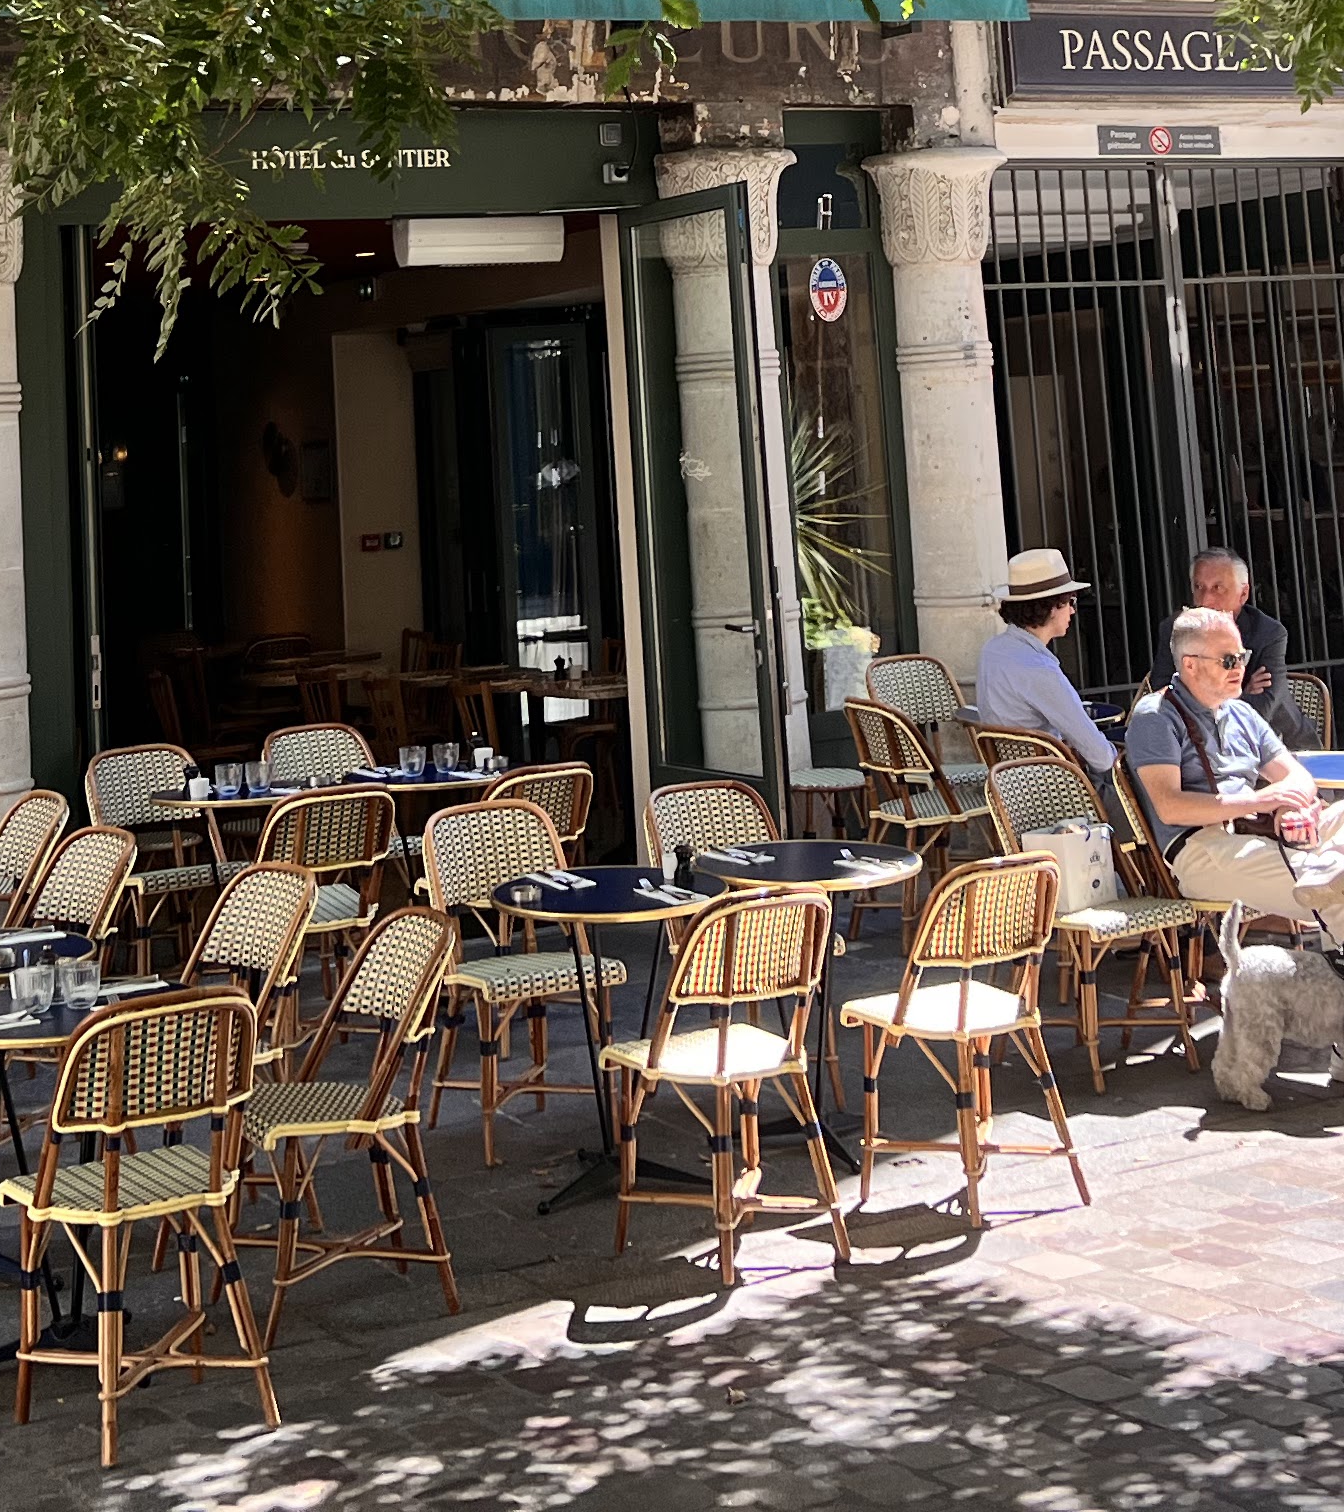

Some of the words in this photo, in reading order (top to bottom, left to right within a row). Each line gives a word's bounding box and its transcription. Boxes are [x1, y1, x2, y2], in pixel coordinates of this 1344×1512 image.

[1059, 29, 1241, 72] PASSAGE
[251, 145, 327, 169] HÔTEL
[361, 148, 451, 169] SNTIER
